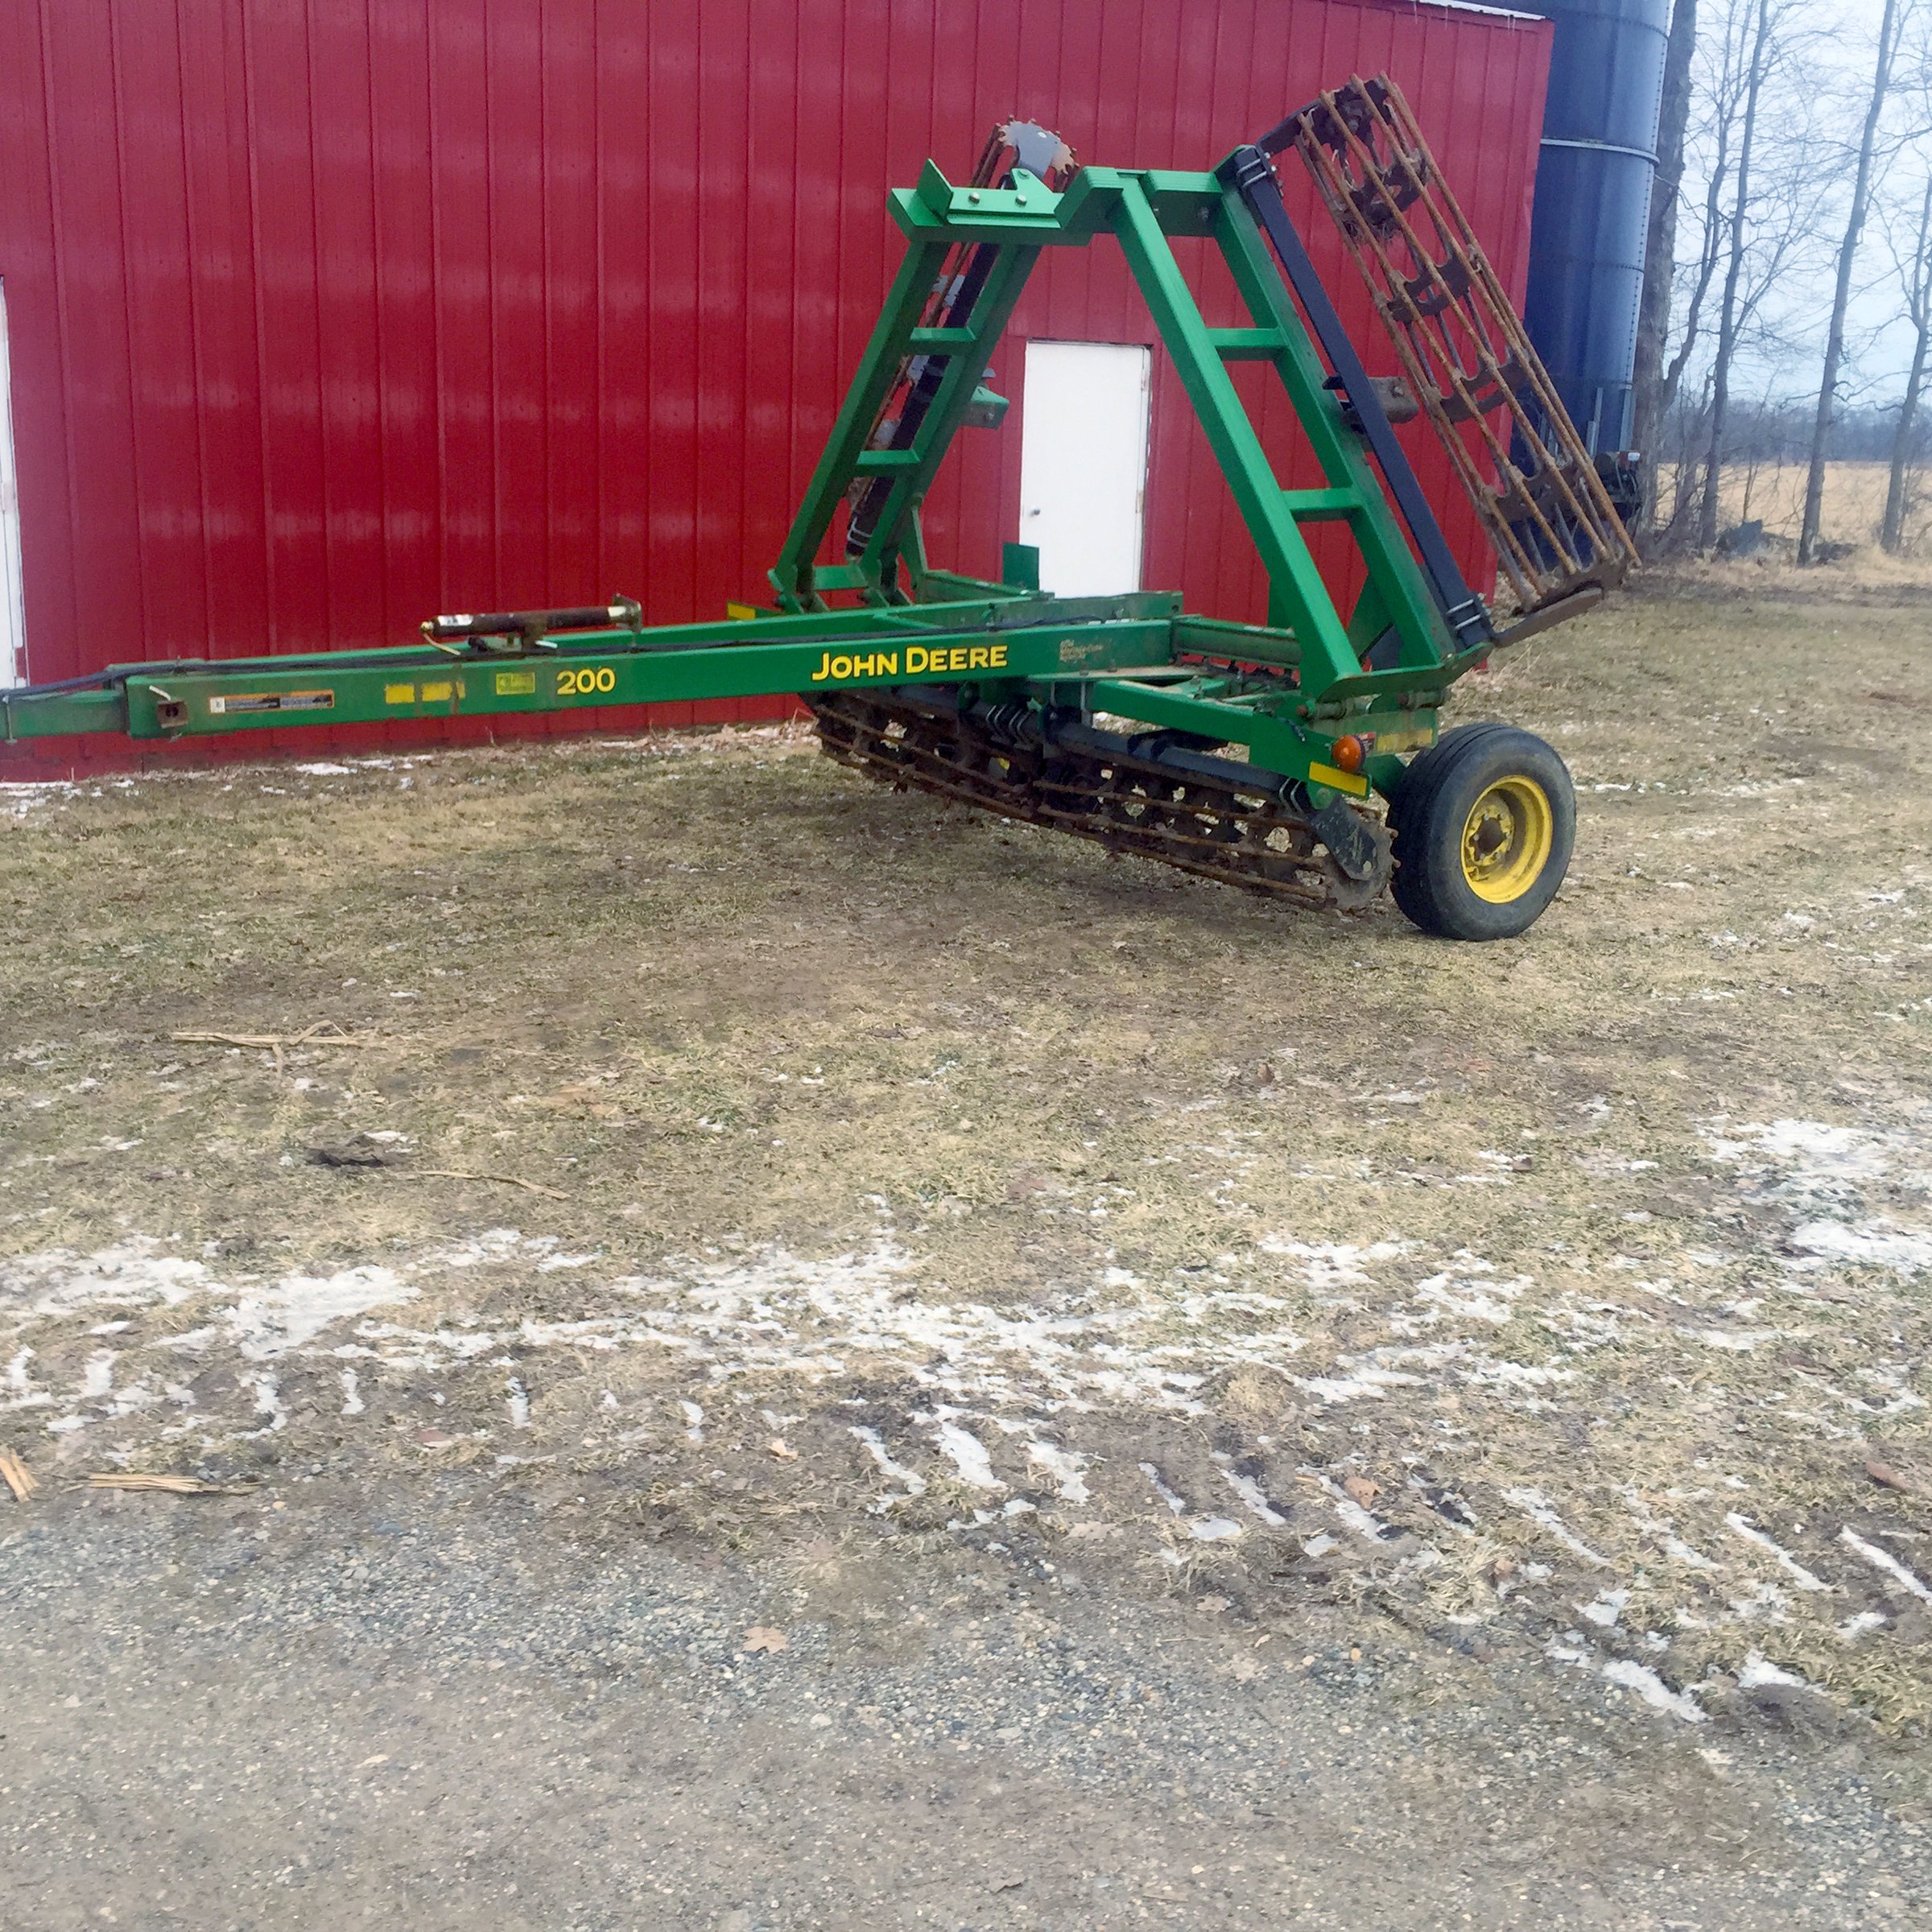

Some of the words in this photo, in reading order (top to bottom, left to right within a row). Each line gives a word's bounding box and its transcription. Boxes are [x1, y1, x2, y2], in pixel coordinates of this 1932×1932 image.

[811, 652, 898, 681] JOHN
[906, 646, 1008, 675] DEERE
[556, 667, 616, 696] 200
